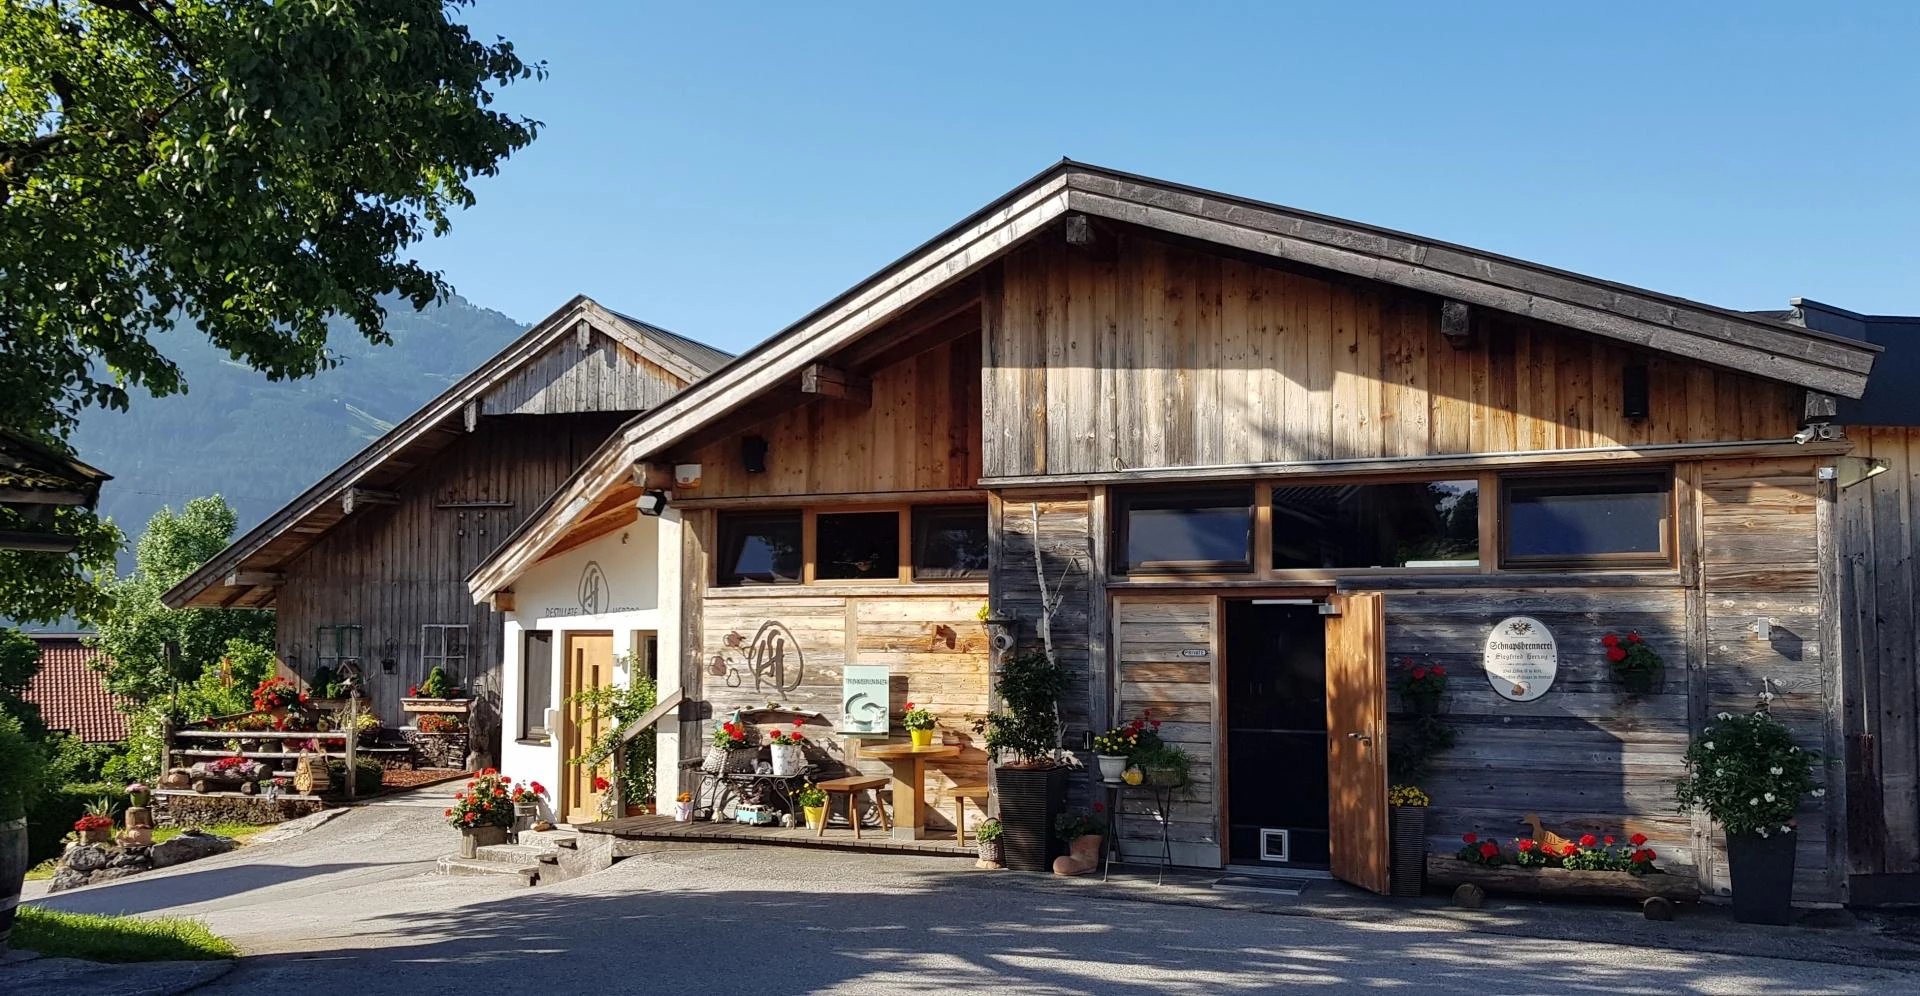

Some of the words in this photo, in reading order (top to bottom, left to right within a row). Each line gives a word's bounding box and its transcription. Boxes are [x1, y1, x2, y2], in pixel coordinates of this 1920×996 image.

[1489, 641, 1553, 651] Schnapsbrennerei
[1495, 653, 1524, 661] Siegfried
[1526, 653, 1548, 661] Herzog
